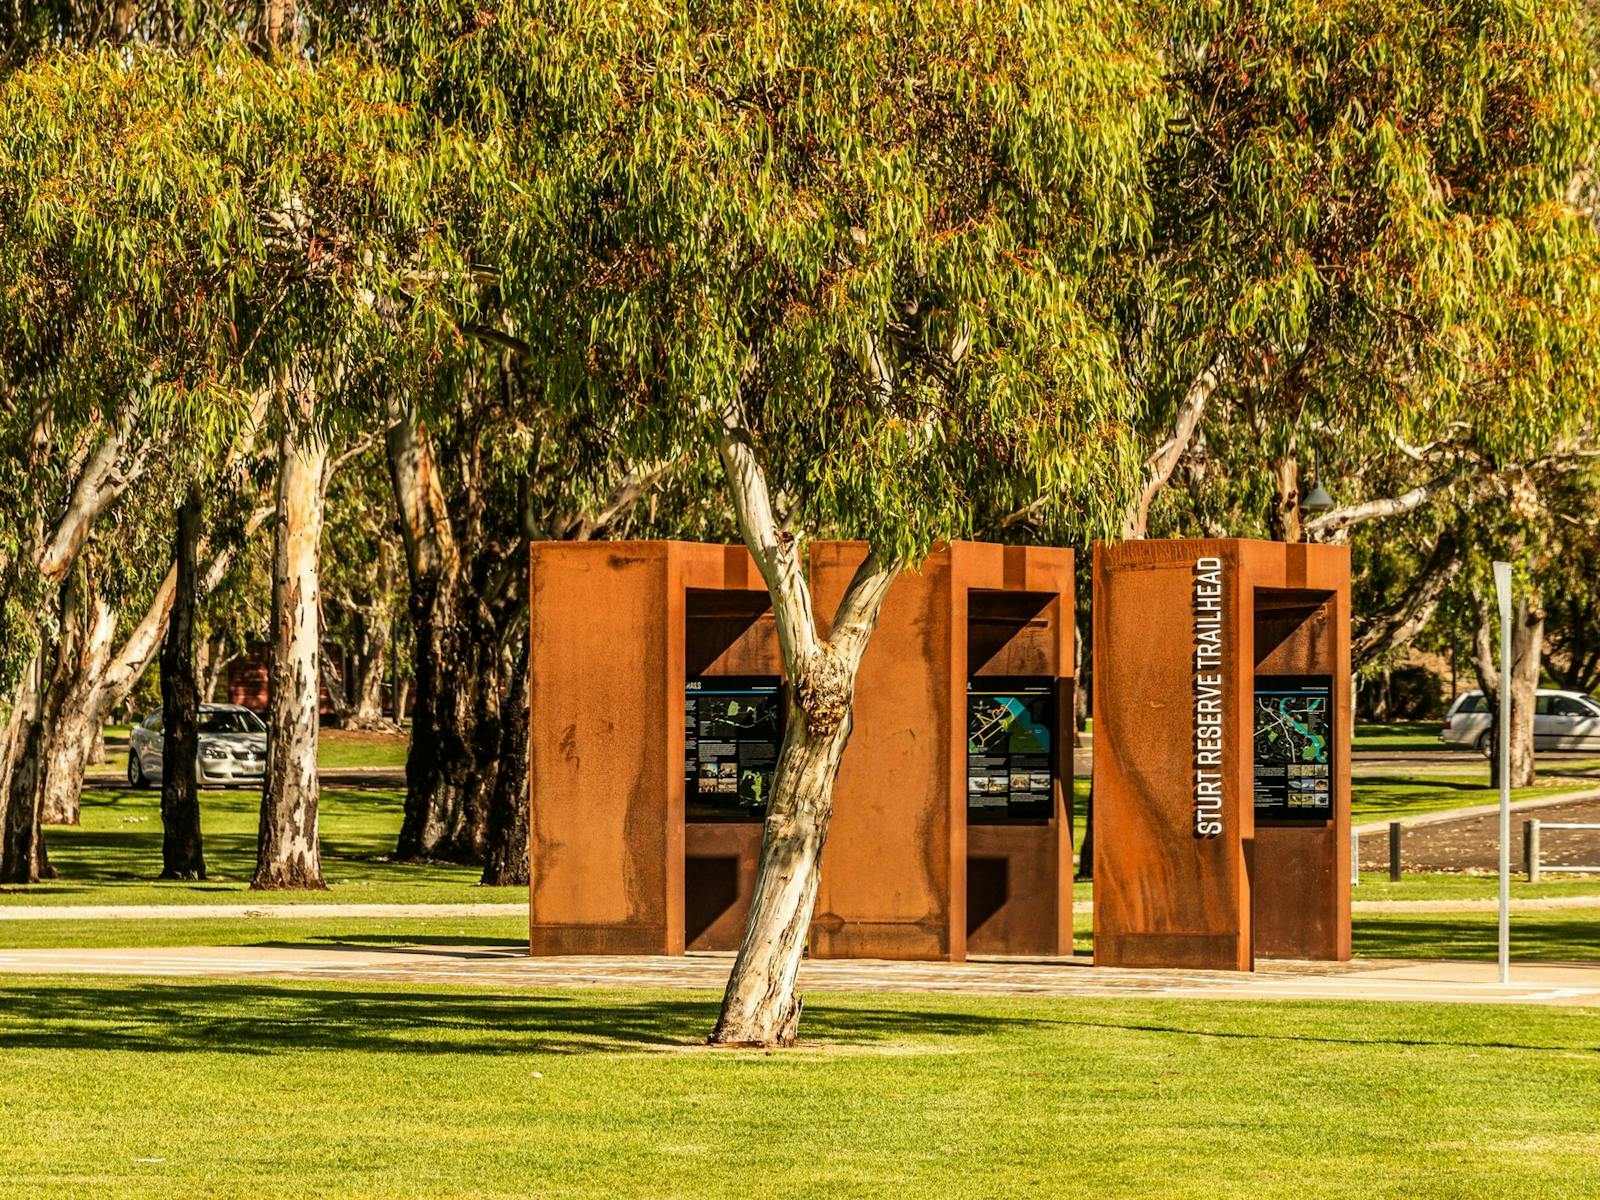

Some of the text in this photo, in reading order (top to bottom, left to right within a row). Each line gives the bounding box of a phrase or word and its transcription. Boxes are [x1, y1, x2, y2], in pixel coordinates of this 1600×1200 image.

[1197, 557, 1222, 835] STURT RESERVE TRAILHEAD
